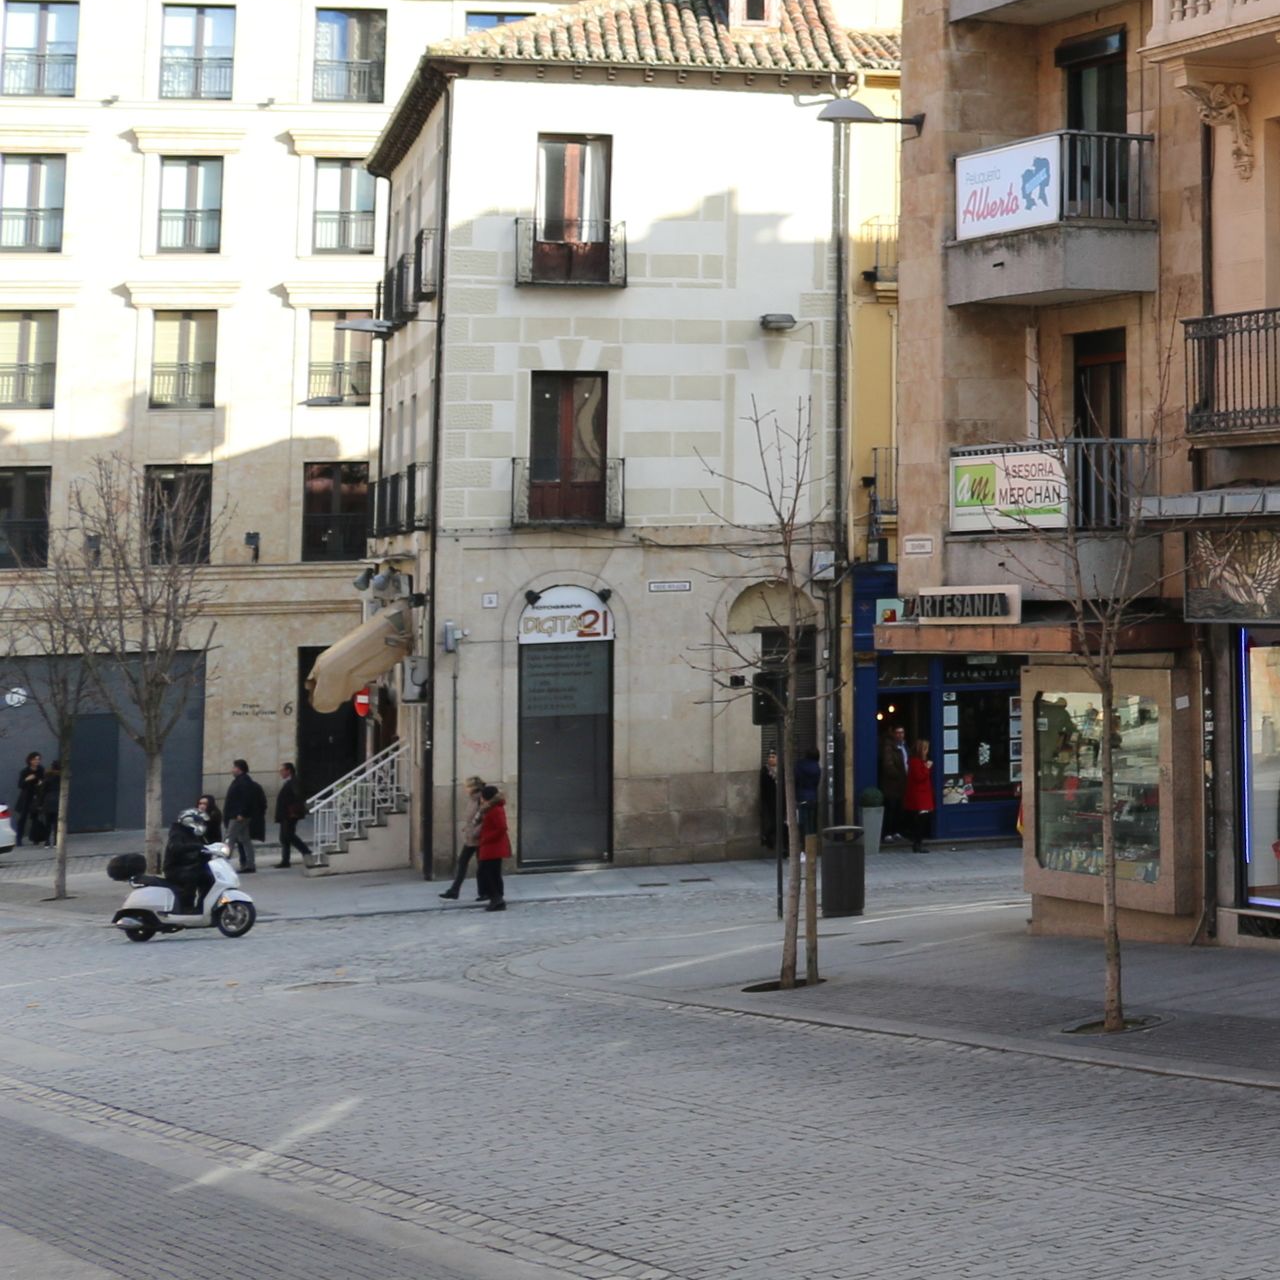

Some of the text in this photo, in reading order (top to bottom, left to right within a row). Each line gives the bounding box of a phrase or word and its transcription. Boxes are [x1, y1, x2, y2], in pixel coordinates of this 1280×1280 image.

[962, 182, 1020, 224] Alberto
[914, 594, 1001, 618] ARTESANIA
[283, 701, 294, 717] 6
